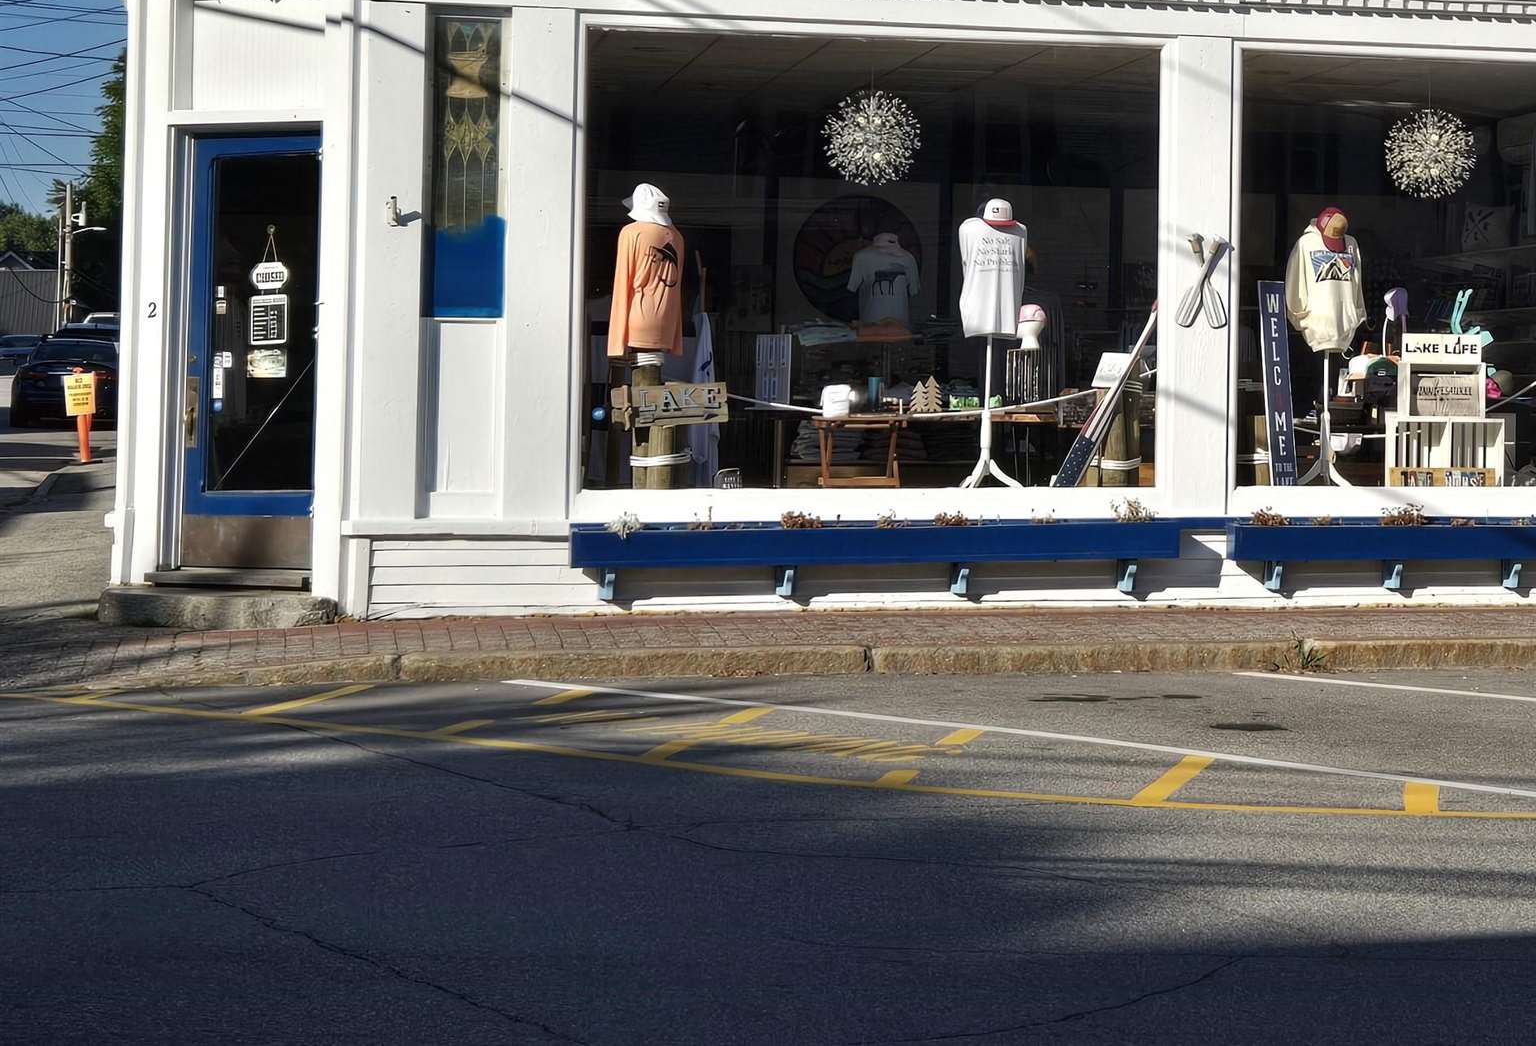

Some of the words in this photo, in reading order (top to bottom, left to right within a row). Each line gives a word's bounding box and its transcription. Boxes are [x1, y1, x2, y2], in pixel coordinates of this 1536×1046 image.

[147, 301, 157, 319] 2
[1405, 342, 1440, 354] LAKE
[1444, 336, 1478, 355] LIFE
[1266, 293, 1287, 456] WELCME
[638, 387, 721, 412] LAKE
